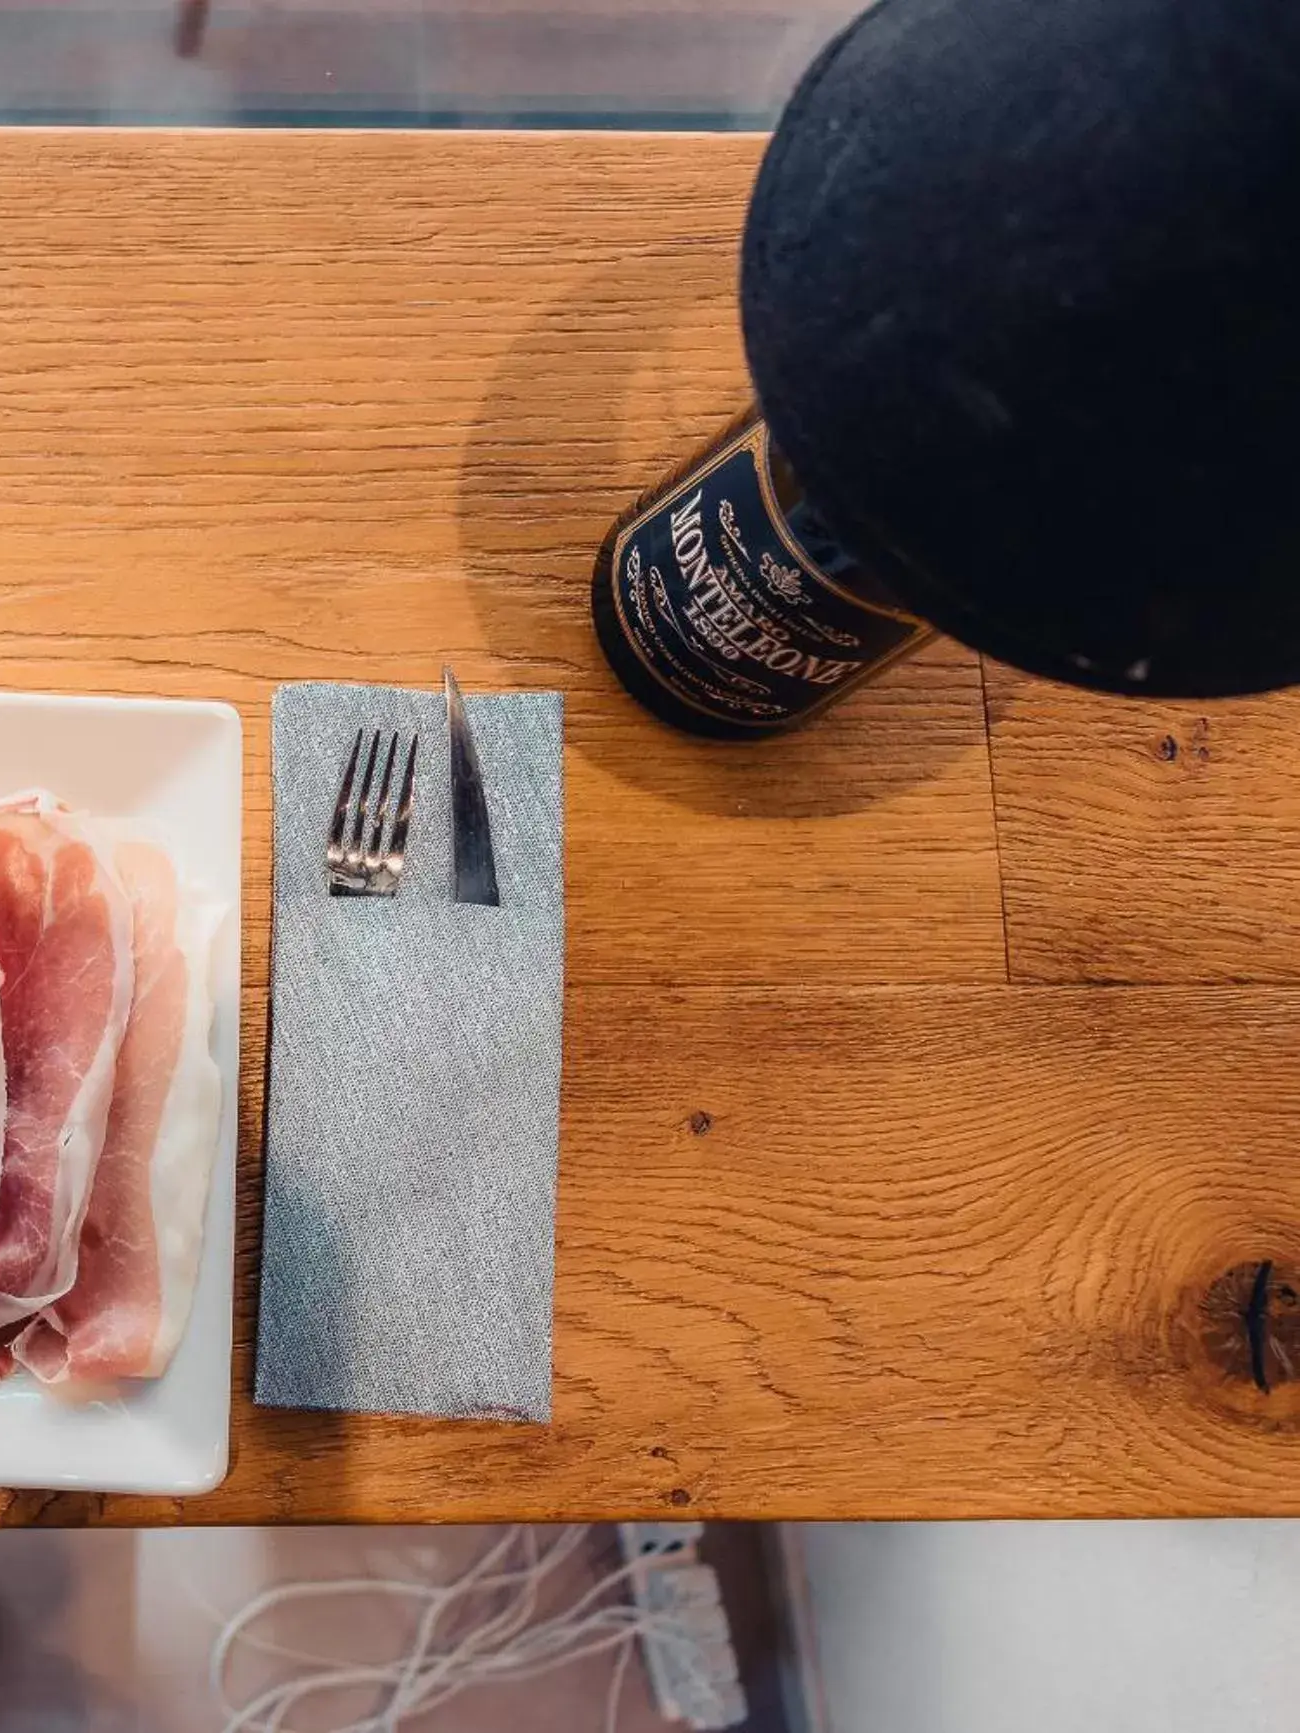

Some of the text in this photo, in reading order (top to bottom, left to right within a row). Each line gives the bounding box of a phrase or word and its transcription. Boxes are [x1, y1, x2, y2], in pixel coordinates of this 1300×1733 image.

[671, 487, 866, 684] MONTELEONE
[714, 565, 790, 641] AMARO
[681, 599, 741, 660] 1890
